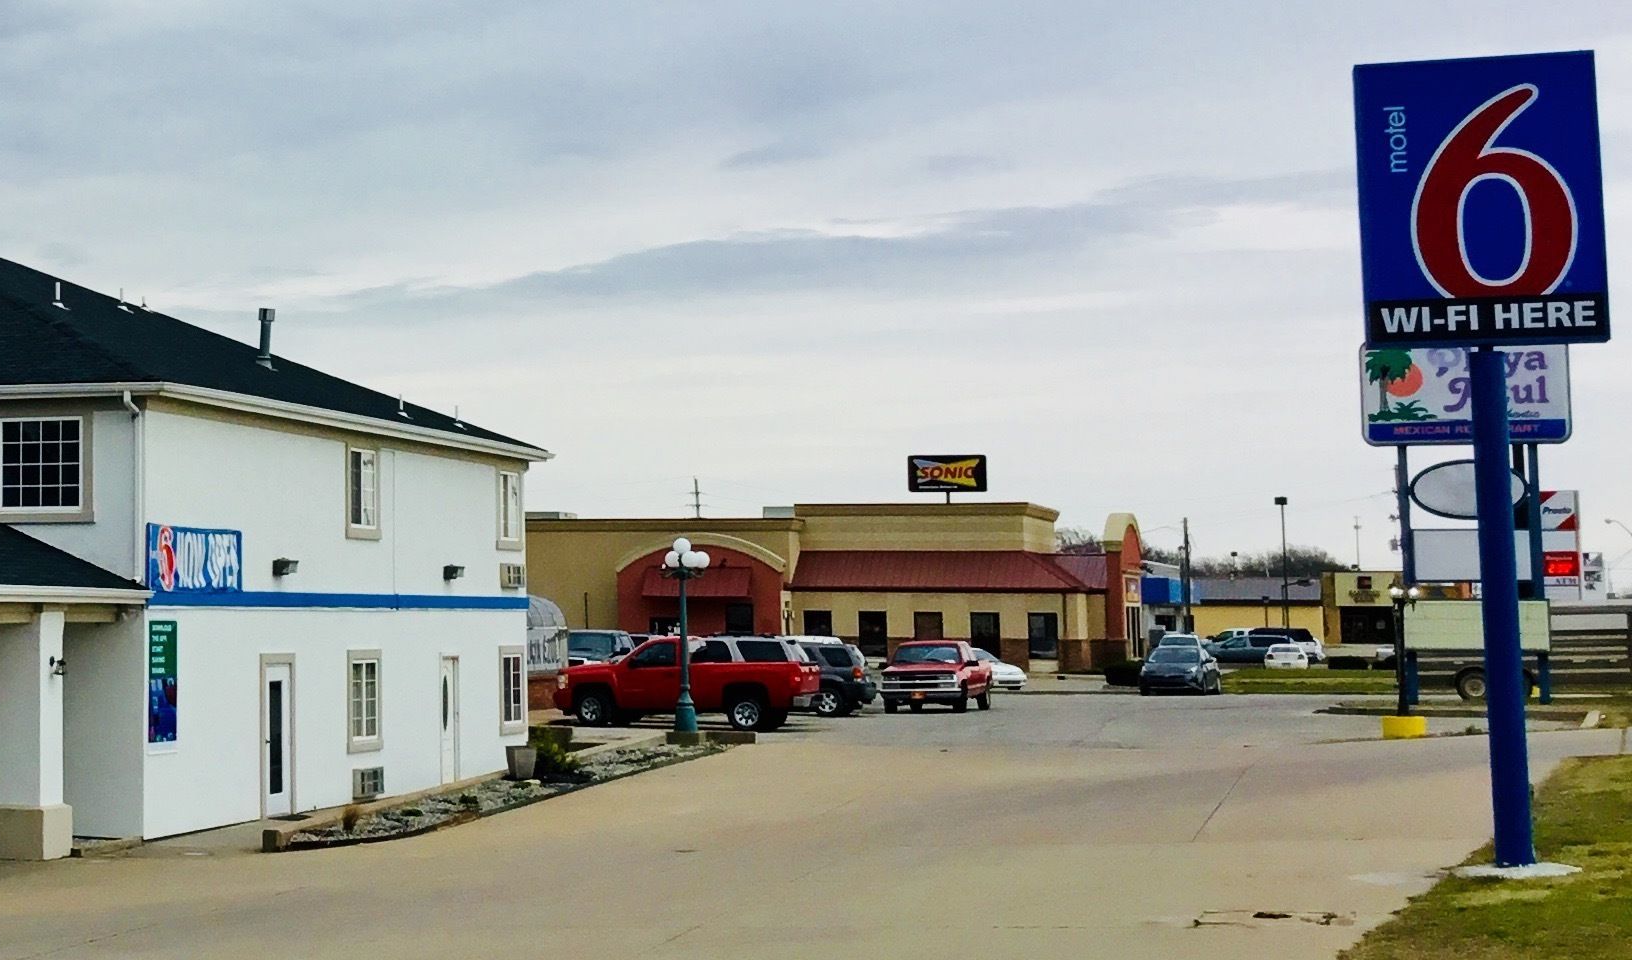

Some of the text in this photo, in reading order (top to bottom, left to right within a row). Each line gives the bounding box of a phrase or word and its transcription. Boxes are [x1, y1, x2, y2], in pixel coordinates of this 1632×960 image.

[1383, 82, 1579, 299] motel 6
[1380, 300, 1597, 334] WI-FI HERE
[1443, 375, 1550, 413] Aul
[1393, 425, 1450, 435] MEXICAN
[919, 466, 975, 479] SONIC
[157, 526, 240, 592] 6 NOW OPEN
